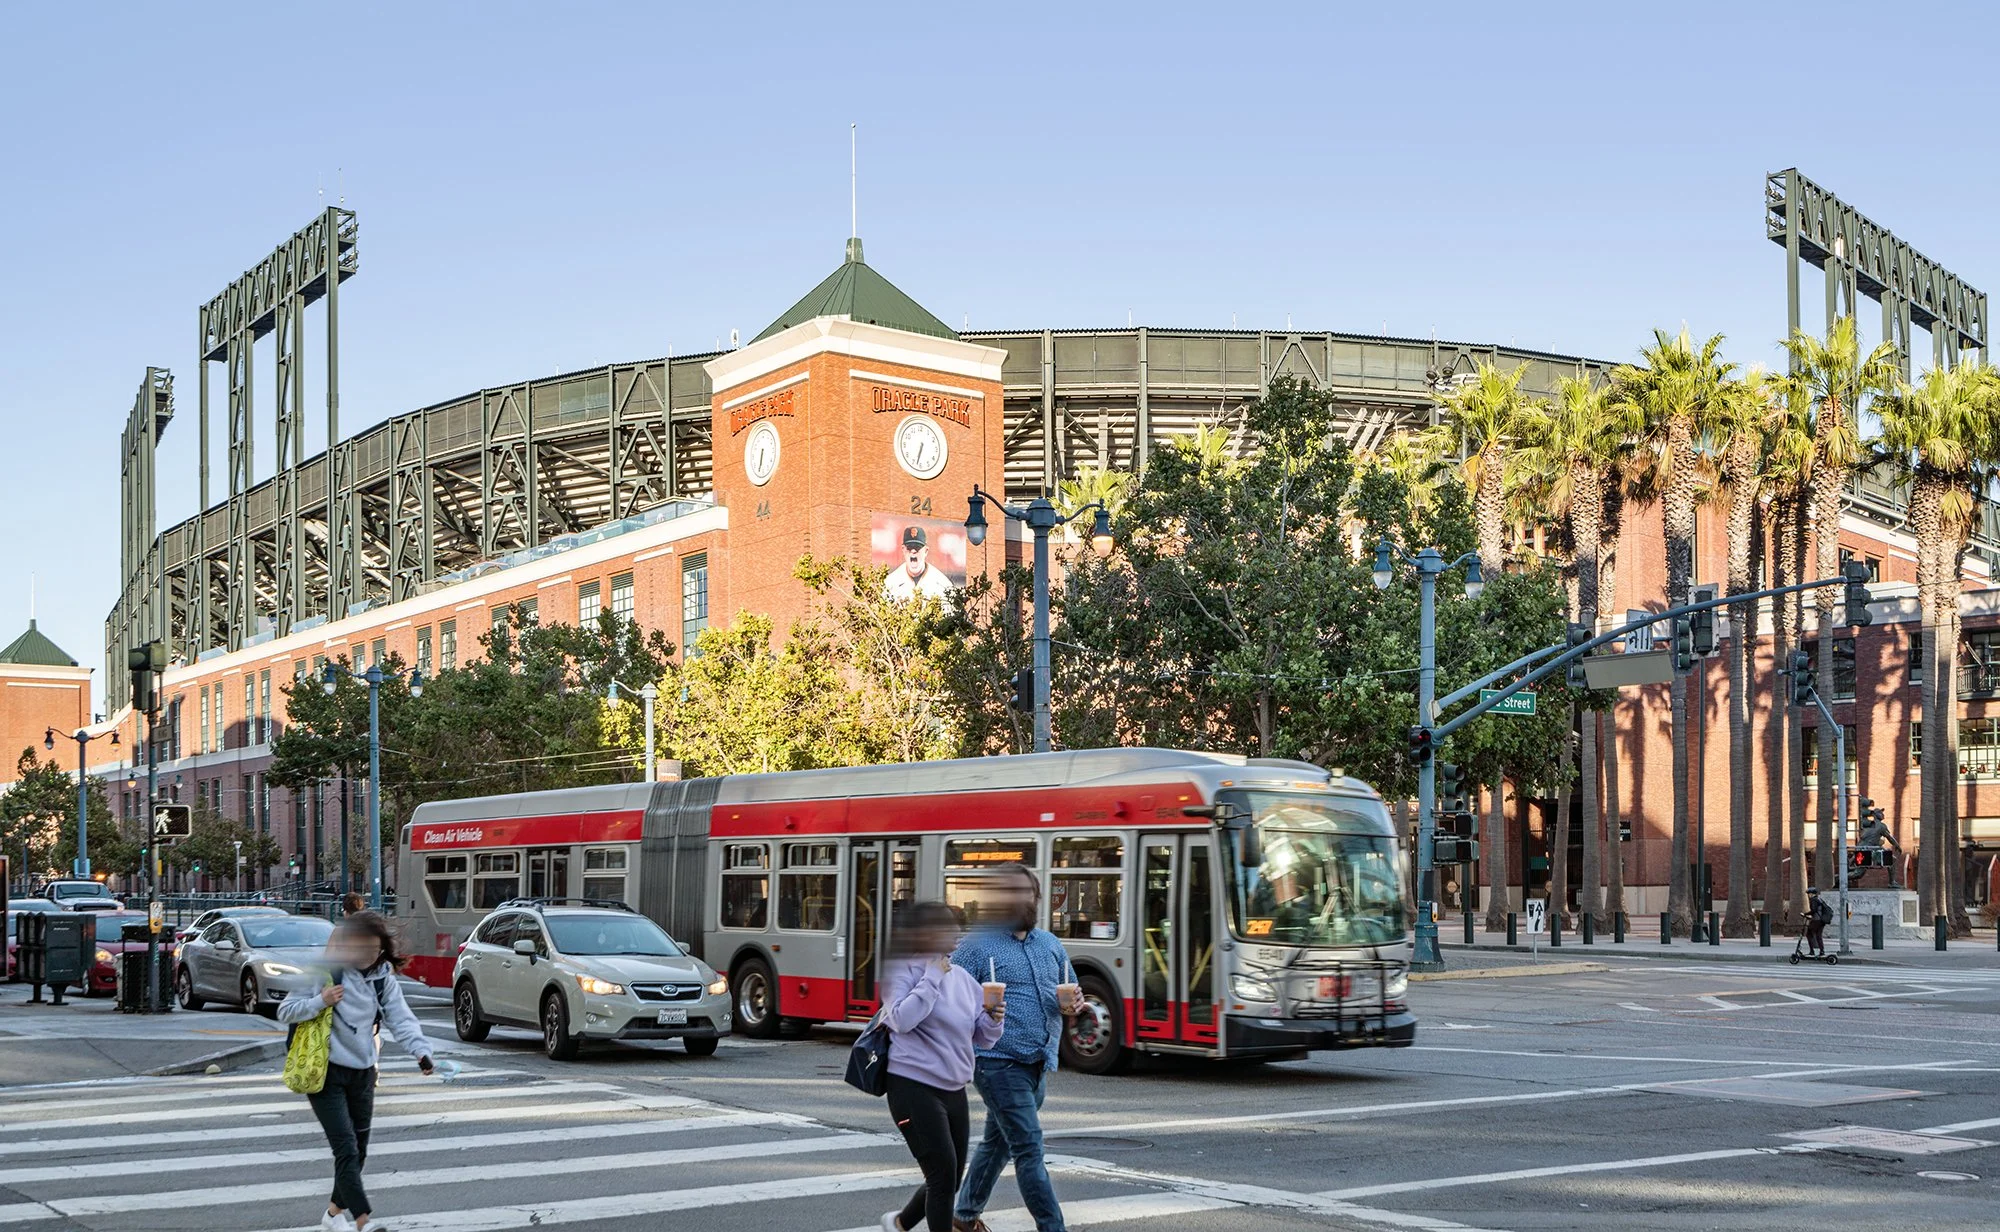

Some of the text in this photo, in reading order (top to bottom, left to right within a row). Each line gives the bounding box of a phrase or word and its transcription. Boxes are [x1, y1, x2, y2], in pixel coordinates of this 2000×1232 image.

[872, 387, 970, 429] ORACLE PARK
[756, 500, 770, 521] 44
[911, 495, 932, 516] 24
[1504, 697, 1530, 709] Street
[424, 829, 444, 844] Clean
[444, 828, 456, 843] Air
[456, 827, 483, 842] Vehicle
